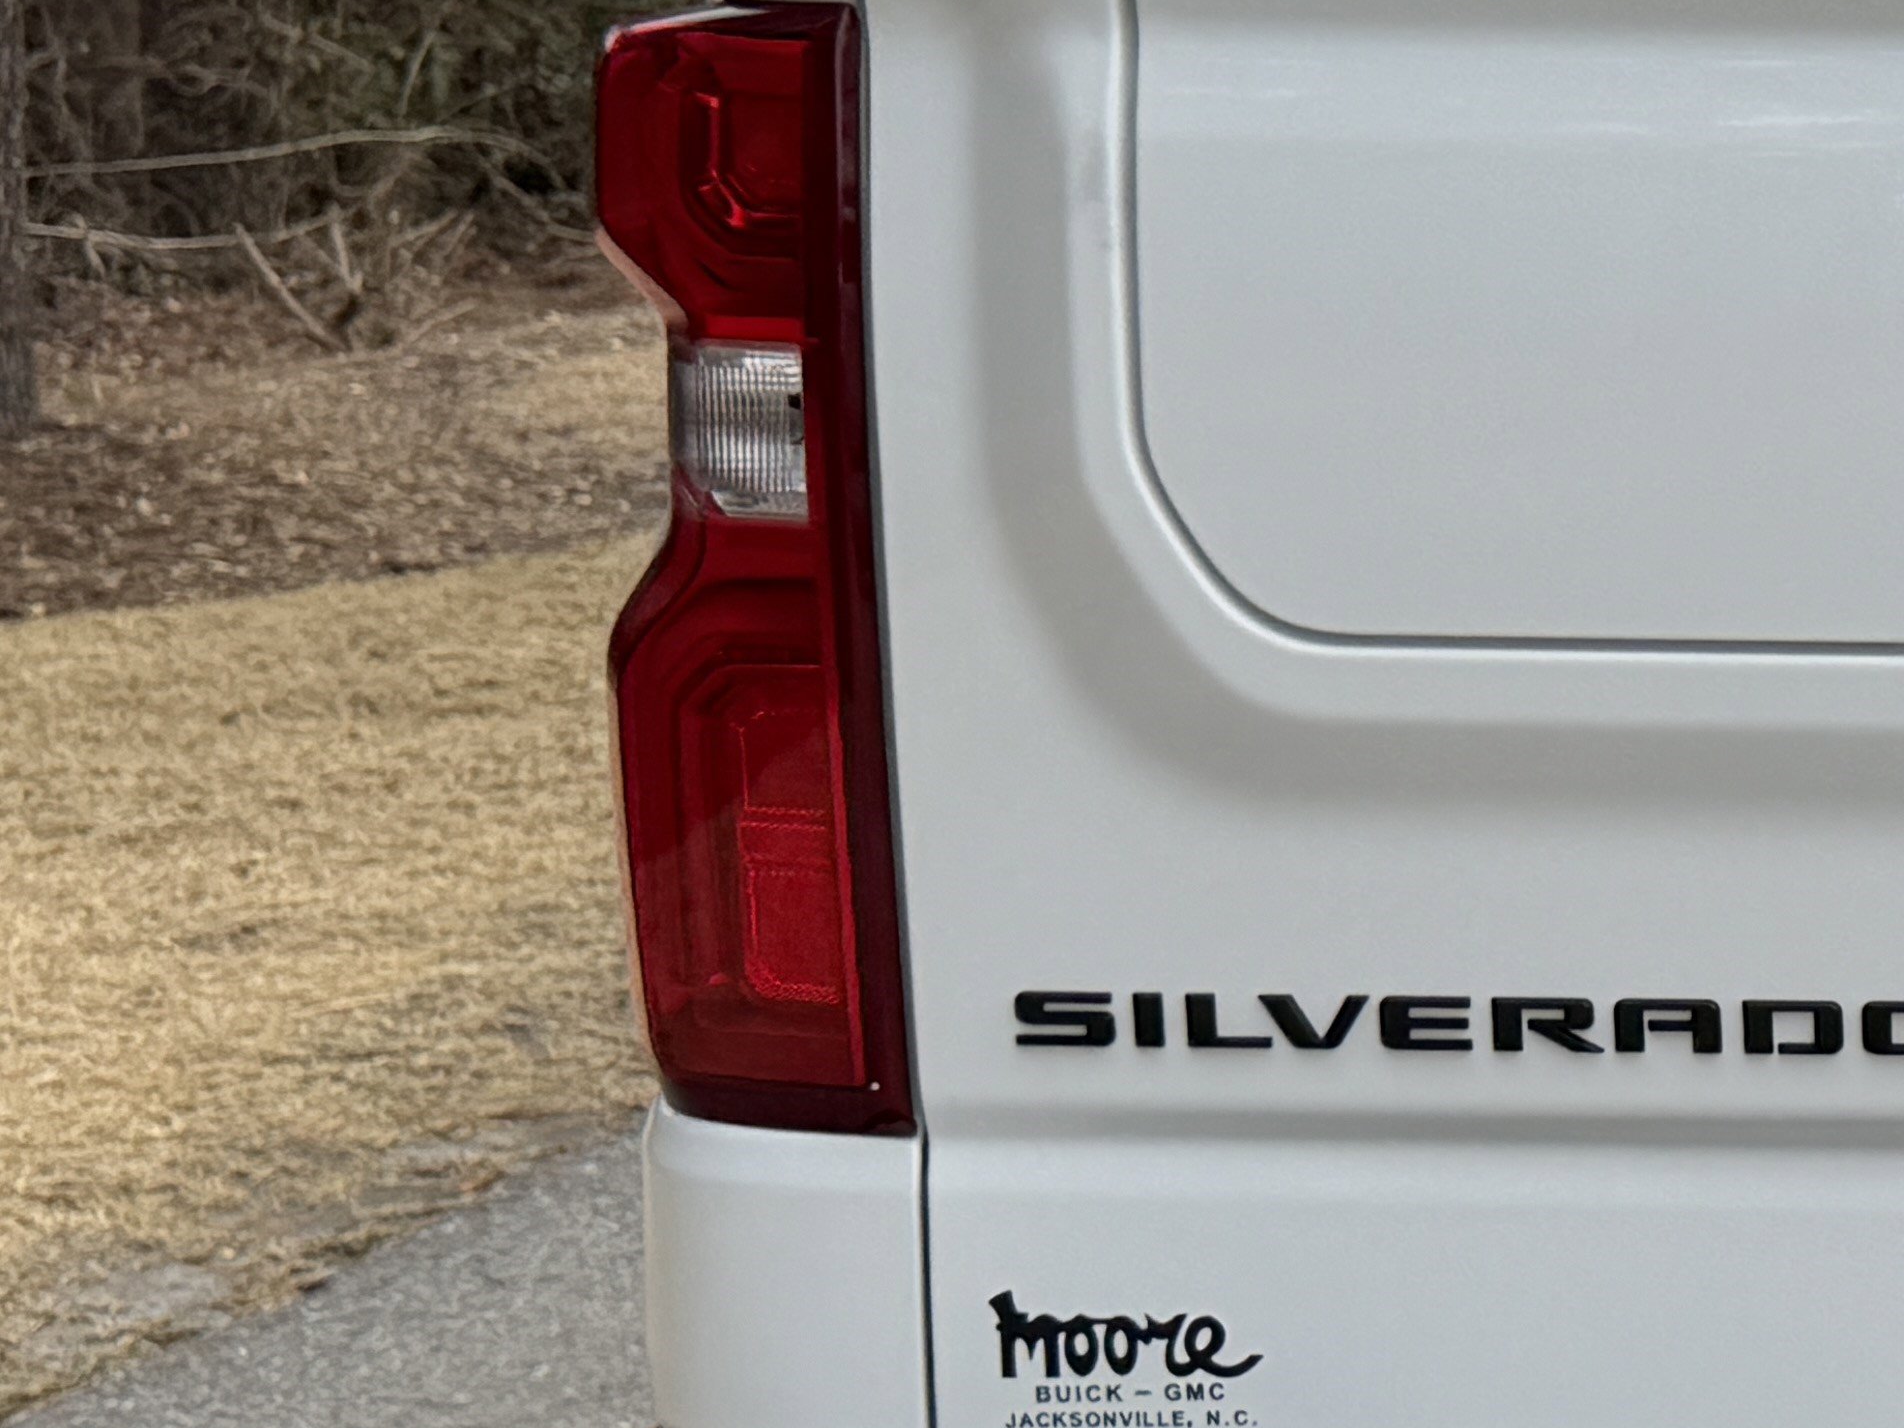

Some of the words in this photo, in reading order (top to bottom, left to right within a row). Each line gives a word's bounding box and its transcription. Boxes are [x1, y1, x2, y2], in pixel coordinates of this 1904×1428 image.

[1035, 1383, 1123, 1404] BUICK
[1164, 1382, 1226, 1402] GMC
[1005, 1410, 1194, 1428] JACKSONVILLE,
[1206, 1409, 1258, 1427] N.C.
